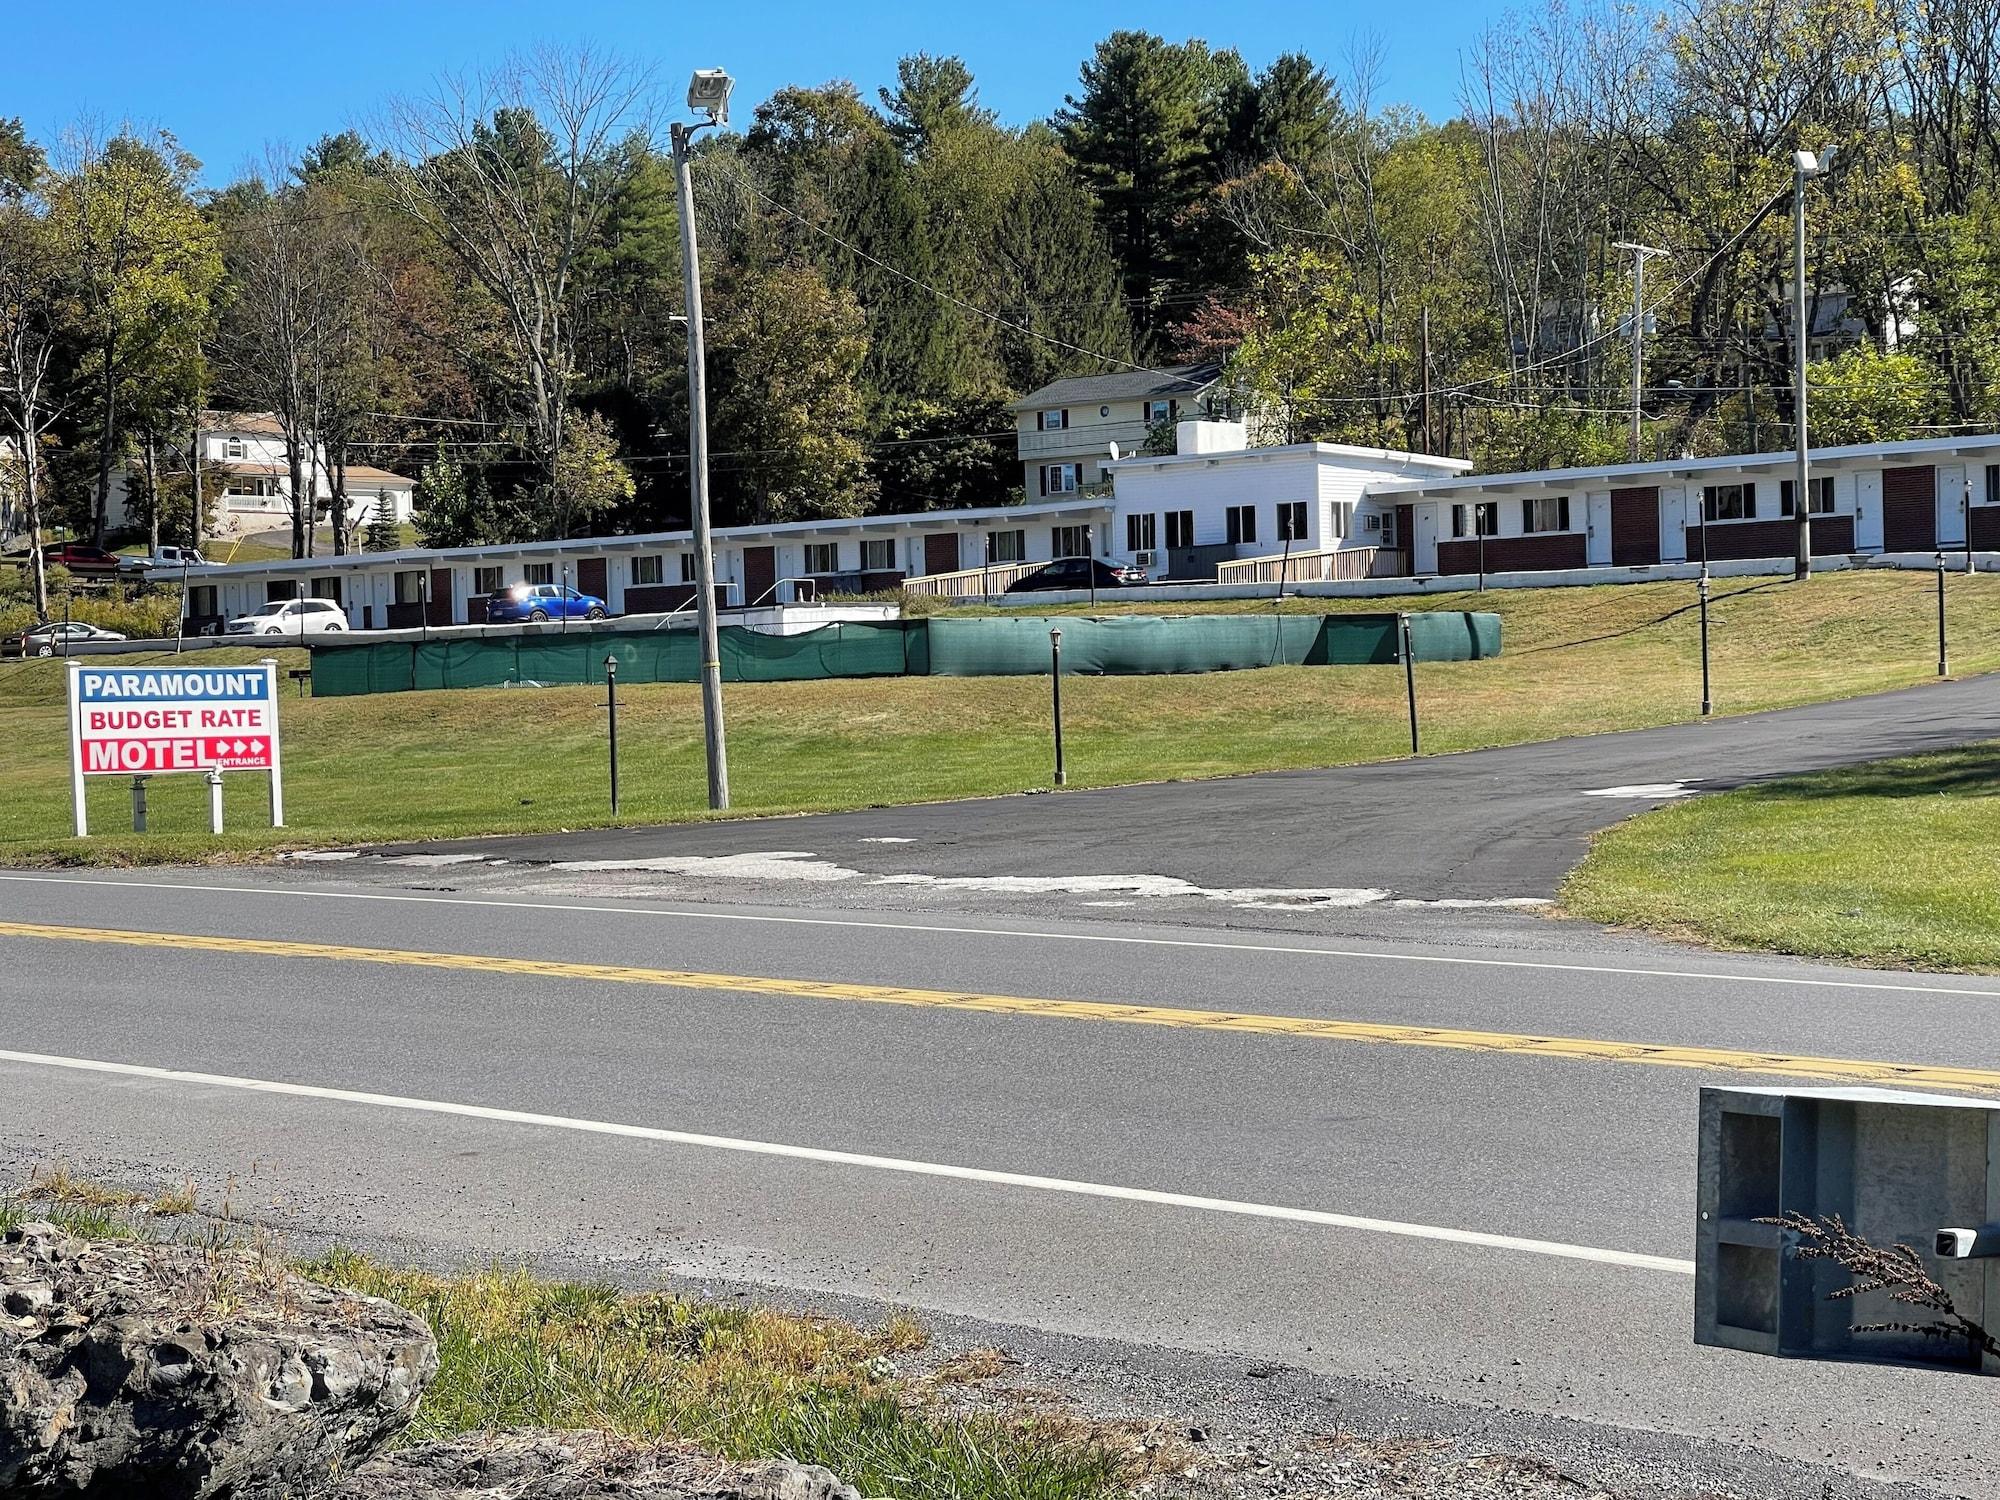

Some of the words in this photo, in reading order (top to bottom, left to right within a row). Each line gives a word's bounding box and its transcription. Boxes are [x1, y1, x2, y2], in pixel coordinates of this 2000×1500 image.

[84, 673, 263, 697] PARAMOUNT
[90, 710, 192, 730] BUDGET
[201, 709, 262, 728] RATE
[88, 739, 217, 770] MOTEL
[217, 756, 266, 766] ENTRANCE
